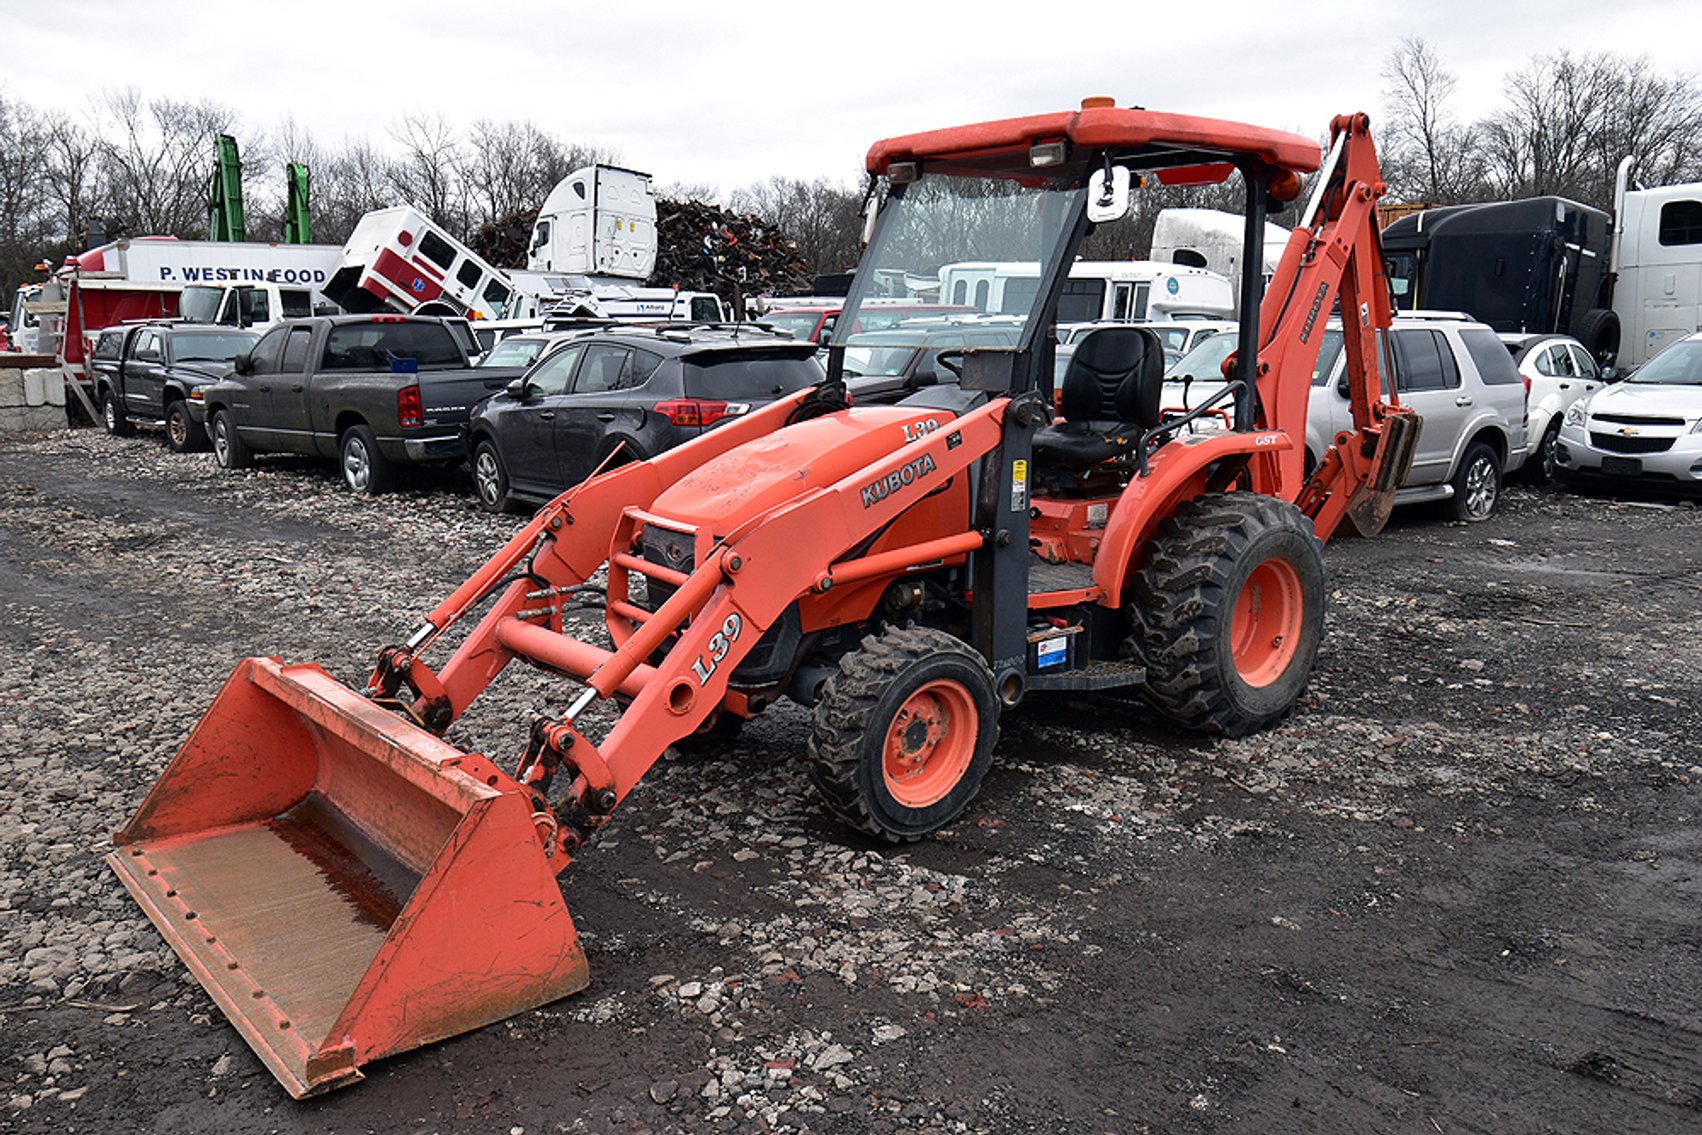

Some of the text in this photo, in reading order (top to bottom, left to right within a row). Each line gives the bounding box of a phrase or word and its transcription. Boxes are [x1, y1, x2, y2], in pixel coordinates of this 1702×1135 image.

[160, 267, 325, 283] P. WESTIN FOOD
[1299, 281, 1329, 345] KUBOTA
[1255, 435, 1278, 446] GST
[860, 453, 937, 509] KUBOTA
[690, 611, 742, 687] L39
